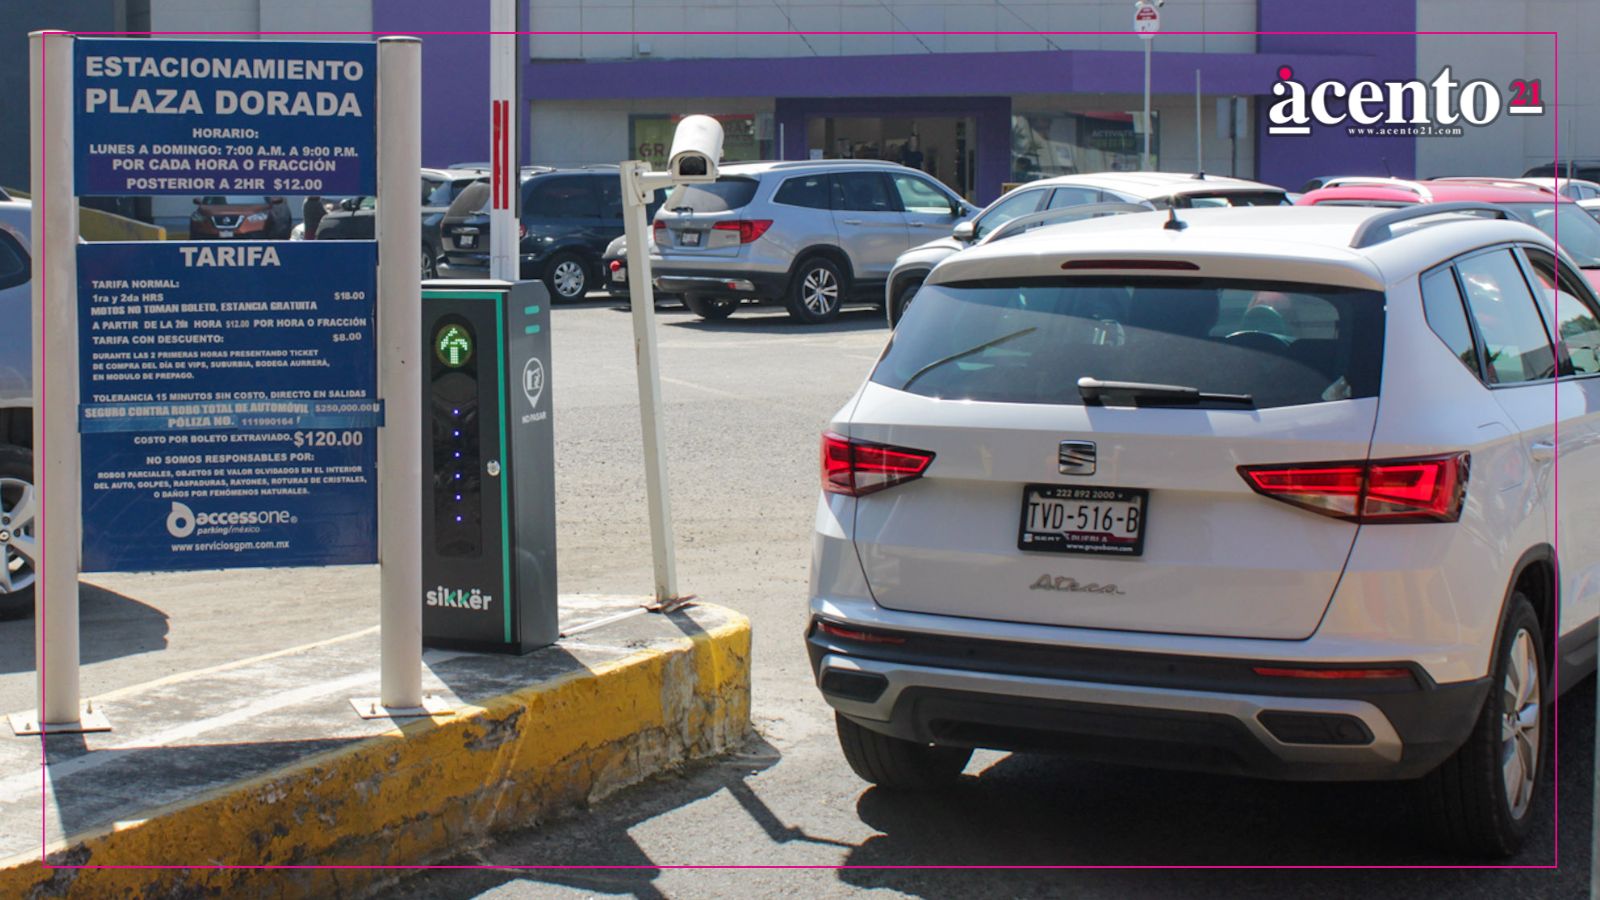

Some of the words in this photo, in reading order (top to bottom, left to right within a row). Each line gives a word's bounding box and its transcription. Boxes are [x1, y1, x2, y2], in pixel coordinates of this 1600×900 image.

[86, 56, 364, 81] ESTACIONAMIENTO
[86, 88, 204, 114] PLAZA
[216, 90, 362, 116] DORADA
[192, 128, 259, 138] HORARIO:
[90, 144, 135, 154] LUNES
[139, 144, 149, 155] A
[152, 144, 222, 156] DOMINGO:
[226, 146, 253, 156] 7:00
[257, 146, 286, 156] A.M.
[290, 146, 298, 156] A
[302, 146, 330, 157] 9:00
[334, 147, 358, 157] P.M.
[112, 159, 144, 170] POR
[149, 159, 190, 170] CADA
[196, 159, 238, 170] HORA
[243, 160, 254, 170] O
[259, 158, 336, 172] FRACCIÓN
[126, 178, 215, 190] POSTERIOR
[219, 179, 230, 190] A
[234, 179, 264, 190] 2HR
[274, 178, 322, 191] $12.00
[180, 246, 280, 267] TARIFA
[92, 280, 129, 288] TARIFA
[132, 280, 179, 288] NORMAL:
[111, 296, 118, 304] y
[121, 294, 139, 302] 2da
[142, 293, 164, 301] HRS
[91, 307, 125, 315] MOTOS
[128, 306, 140, 314] NO
[144, 305, 179, 314] TOMAN
[221, 302, 268, 311] ESTANCIA
[270, 301, 317, 310] GRATUITA
[92, 321, 99, 330] A
[102, 321, 138, 329] PARTIR
[144, 321, 156, 329] DE
[160, 320, 173, 329] LA
[194, 320, 222, 328] HORA
[254, 319, 274, 327] POR
[277, 319, 304, 327] HORA
[307, 318, 314, 327] O
[317, 317, 367, 326] FRACCIÓN
[92, 336, 129, 344] TARIFA
[132, 336, 154, 344] CON
[158, 335, 224, 343] DESCUENTO:
[333, 333, 362, 342] $8.00
[200, 349, 227, 358] HORAS
[160, 361, 173, 369] DÍA
[188, 361, 208, 369] VIPS,
[211, 359, 253, 369] SUBURBIA,
[93, 394, 153, 402] TOLERANCIA
[170, 392, 212, 400] MINUTOS
[215, 391, 230, 400] SIN
[234, 391, 268, 400] COSTO,
[85, 408, 125, 417] SEGURO
[128, 406, 169, 416] CONTRA
[172, 405, 201, 415] ROBO
[203, 403, 233, 415] TOTAL
[235, 404, 248, 412] DE
[251, 402, 308, 413] AUTOMÓVIL
[214, 415, 234, 427] NO.
[191, 434, 227, 443] BOLETO
[294, 431, 363, 448] $120.00
[165, 456, 202, 464] SOMOS
[205, 453, 287, 462] RESPONSABLES
[290, 453, 314, 461] POR:
[128, 470, 174, 478] PARCIALES,
[174, 479, 228, 488] RASPADURAS,
[162, 489, 188, 497] DAÑOS
[1029, 503, 1139, 533] TVD-516-B
[427, 585, 491, 610] sikkër
